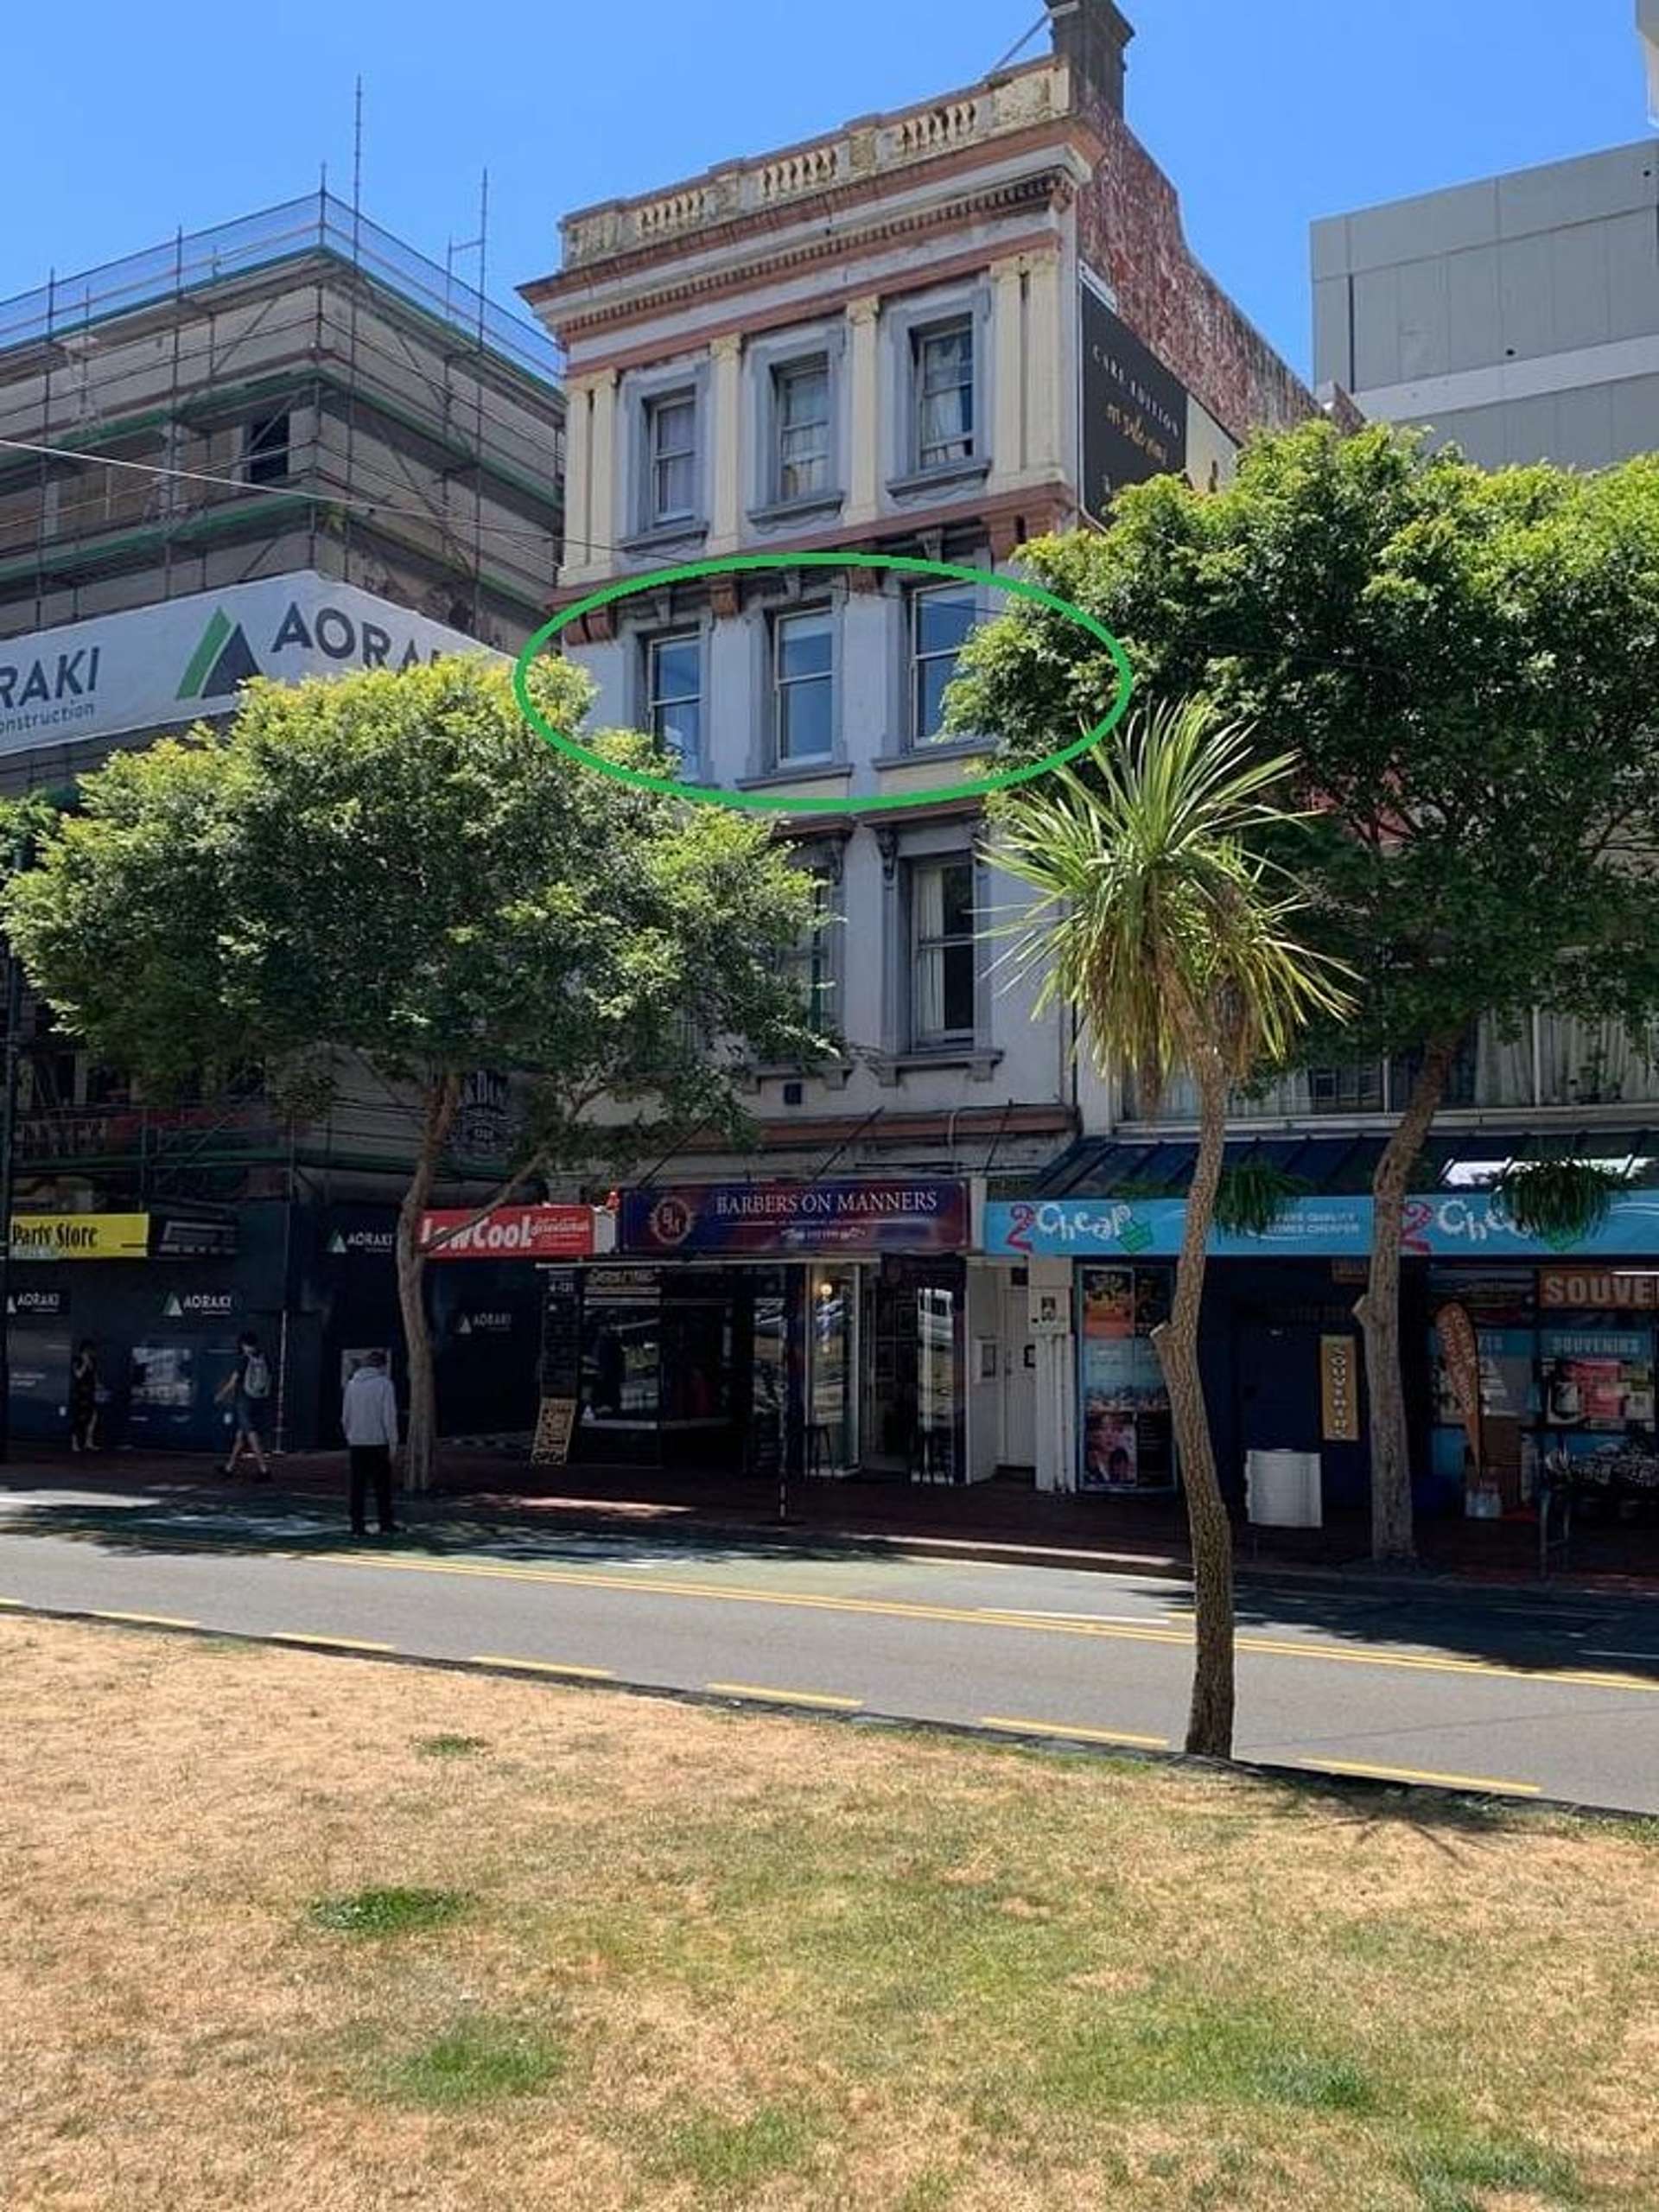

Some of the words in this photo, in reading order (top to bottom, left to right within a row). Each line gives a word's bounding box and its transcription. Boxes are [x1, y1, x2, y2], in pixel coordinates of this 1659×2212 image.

[271, 601, 441, 677] AORA
[715, 1195, 798, 1215] BARBERS
[801, 1193, 832, 1212] ON
[836, 1191, 938, 1211] MANNERS
[56, 1222, 98, 1248] Store
[1006, 1204, 1036, 1255] 2
[1037, 1204, 1132, 1241] Cheap
[1401, 1201, 1433, 1253] 2
[1437, 1200, 1534, 1239] Chea
[183, 1294, 232, 1309] AORAKI
[1545, 1274, 1659, 1304] SOUVE
